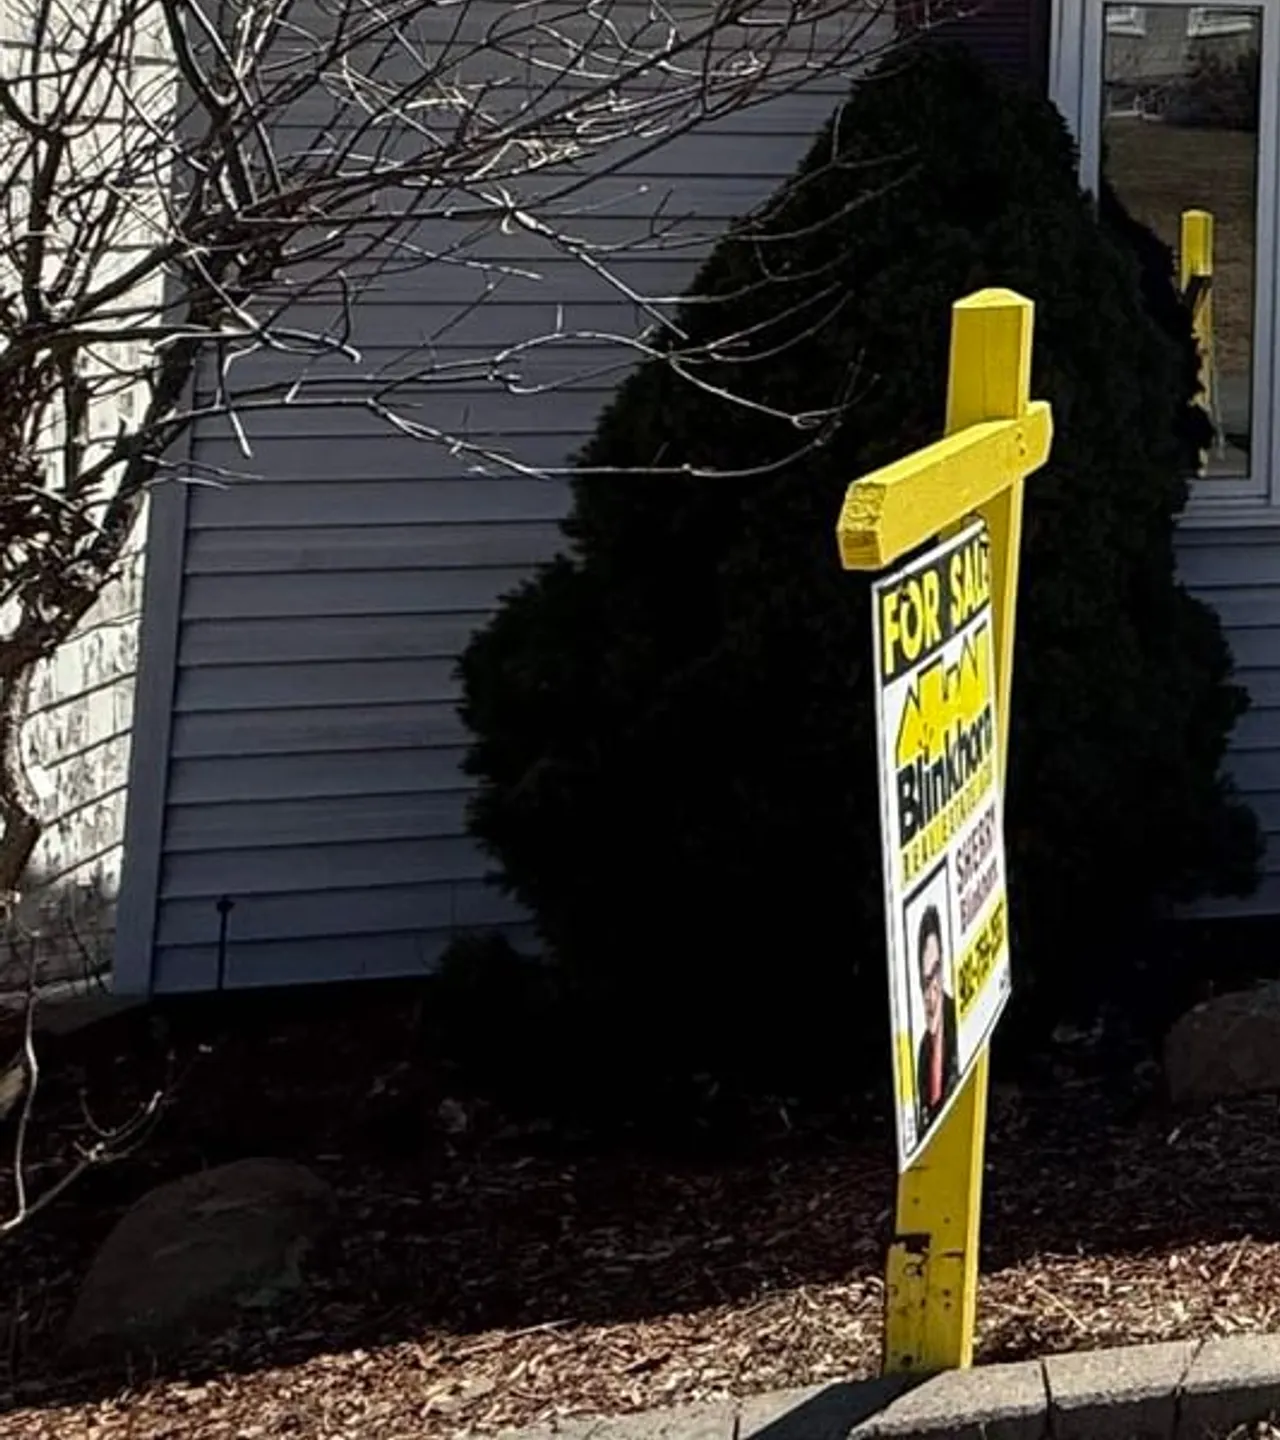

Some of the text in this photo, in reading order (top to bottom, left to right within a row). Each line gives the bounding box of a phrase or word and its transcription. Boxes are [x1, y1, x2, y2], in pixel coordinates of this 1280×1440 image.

[883, 536, 990, 674] FOR SALE
[898, 703, 992, 847] Blinkhorn
